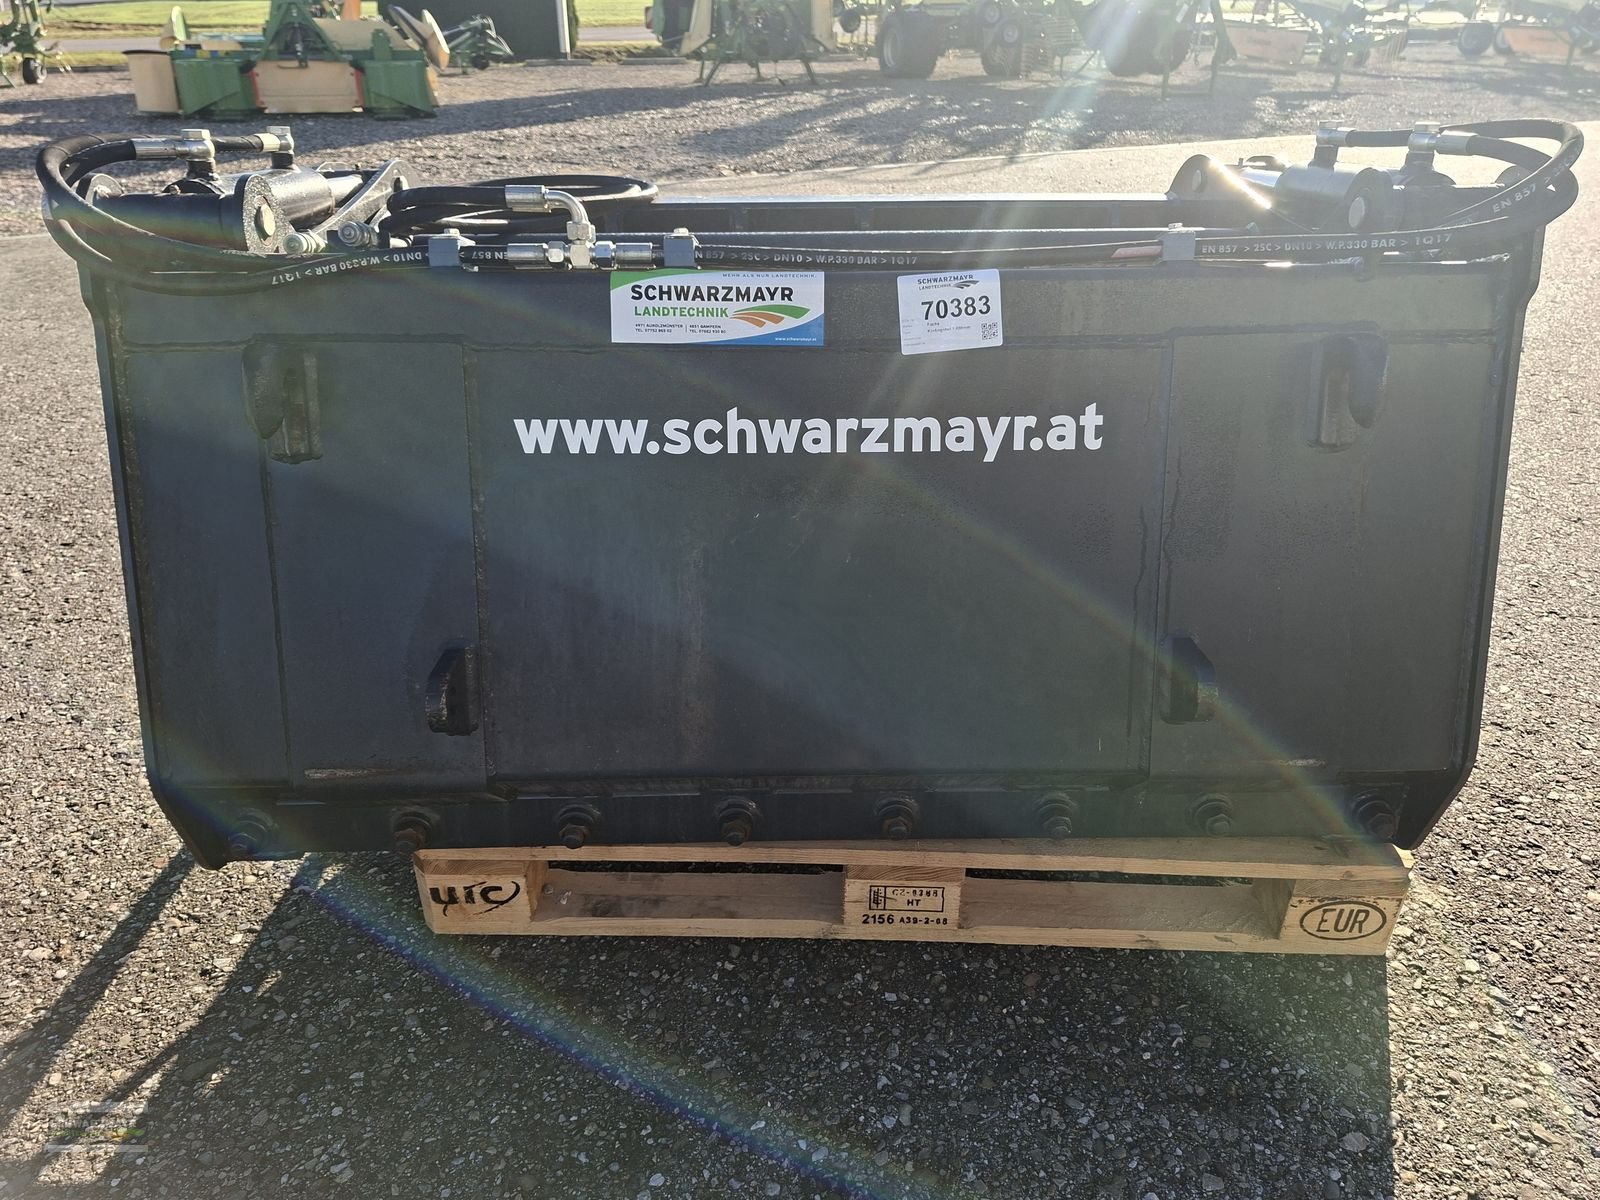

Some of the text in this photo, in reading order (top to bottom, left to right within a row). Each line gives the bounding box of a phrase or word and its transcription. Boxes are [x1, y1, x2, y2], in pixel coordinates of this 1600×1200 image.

[1492, 198, 1512, 213] EN
[1514, 184, 1536, 201] 857
[1202, 245, 1216, 254] EN
[1218, 244, 1237, 253] 857
[1371, 238, 1396, 248] BAR
[393, 252, 422, 262] DN10
[471, 251, 492, 260] 857
[706, 251, 725, 260] 857
[774, 253, 803, 263] DN10
[856, 256, 877, 265] BAR
[315, 264, 338, 275] BAR
[917, 274, 974, 285] SCHWARZMAYR
[630, 284, 794, 302] SCHWARZMAYR
[634, 306, 729, 318] LANDTECHNIK
[921, 295, 991, 321] 70383
[513, 403, 1104, 463] www.schwarzmayr.at
[907, 899, 921, 907] HT
[862, 913, 895, 925] 2156
[1316, 908, 1370, 933] EUR
